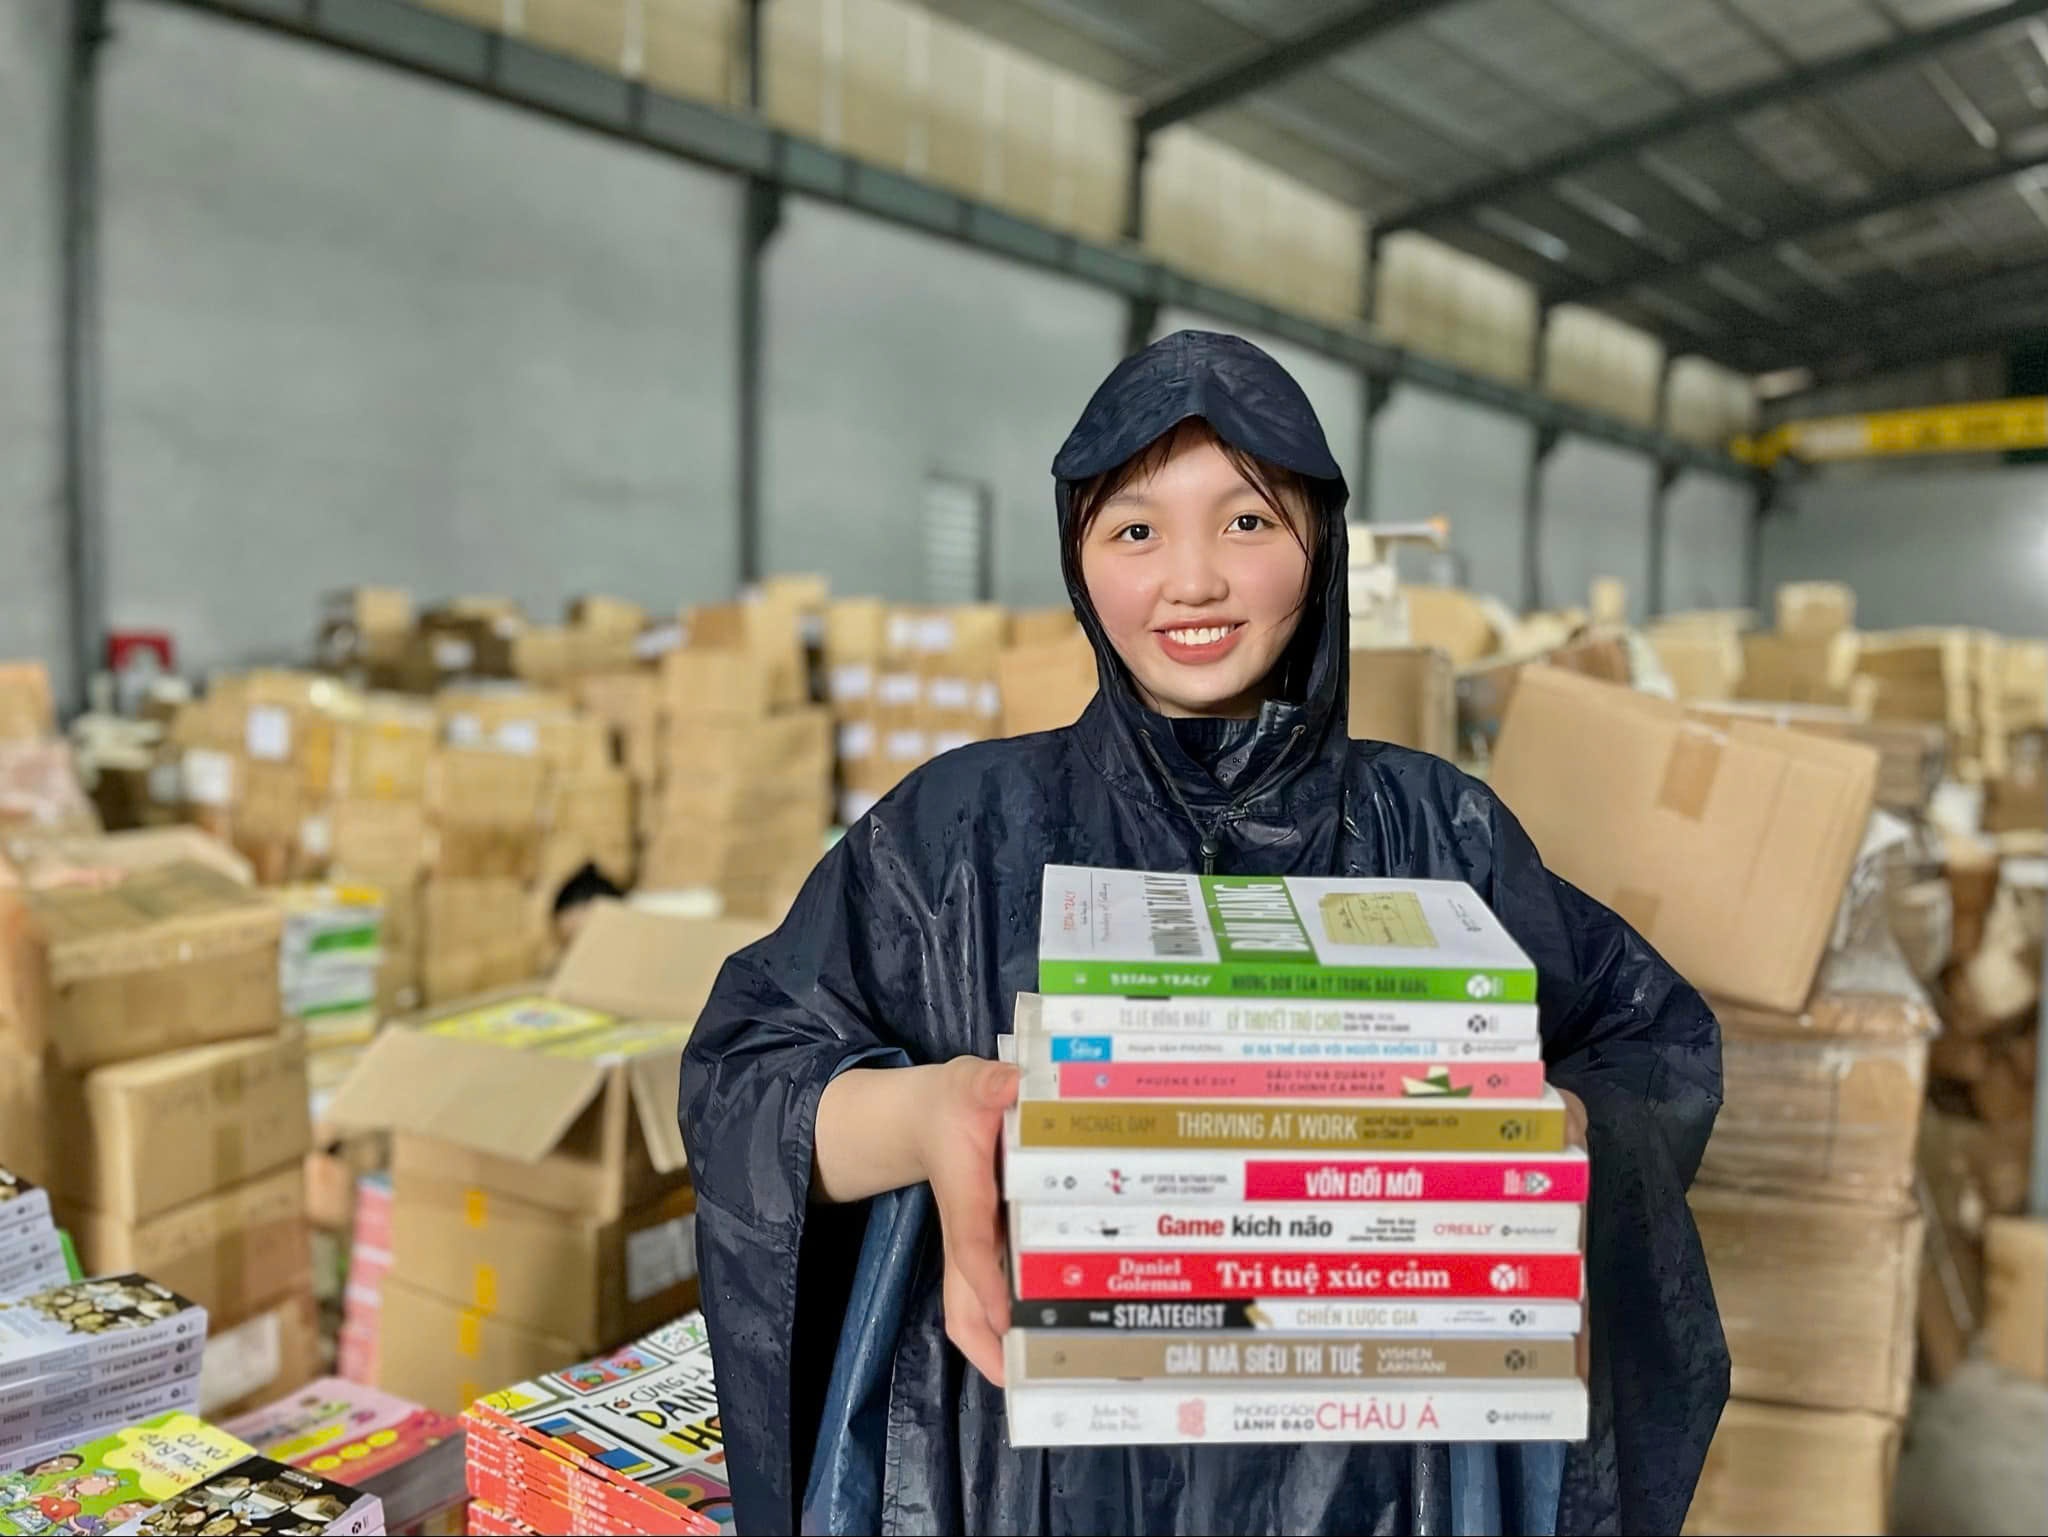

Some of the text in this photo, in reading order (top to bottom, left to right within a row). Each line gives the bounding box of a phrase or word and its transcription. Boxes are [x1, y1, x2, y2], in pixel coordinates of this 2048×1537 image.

[1208, 884, 1310, 950] BÁN HÀNG
[1163, 974, 1213, 988] TRACY
[1070, 1116, 1123, 1133] MICHAEL
[1176, 1112, 1359, 1140] THRIVING AT WORK
[1305, 1166, 1423, 1197] VỐN ĐỔI MỚI
[1157, 1214, 1333, 1238] Game kích não
[1433, 1223, 1494, 1236] O'REILLY
[1119, 1259, 1181, 1276] Daniel
[1216, 1260, 1450, 1295] Trí tuệ xúc cảm
[1107, 1276, 1192, 1293] Goleman
[1090, 1304, 1226, 1327] THE STRATEGIST
[1296, 1305, 1343, 1326] CHIẾN
[1392, 1309, 1419, 1326] GIA
[1245, 1343, 1287, 1373] SIÊU
[1376, 1346, 1433, 1360] VISHEN
[629, 1376, 686, 1402] CŨNG
[1233, 1404, 1279, 1416] PHONG
[1316, 1396, 1440, 1430] CHÂU Á
